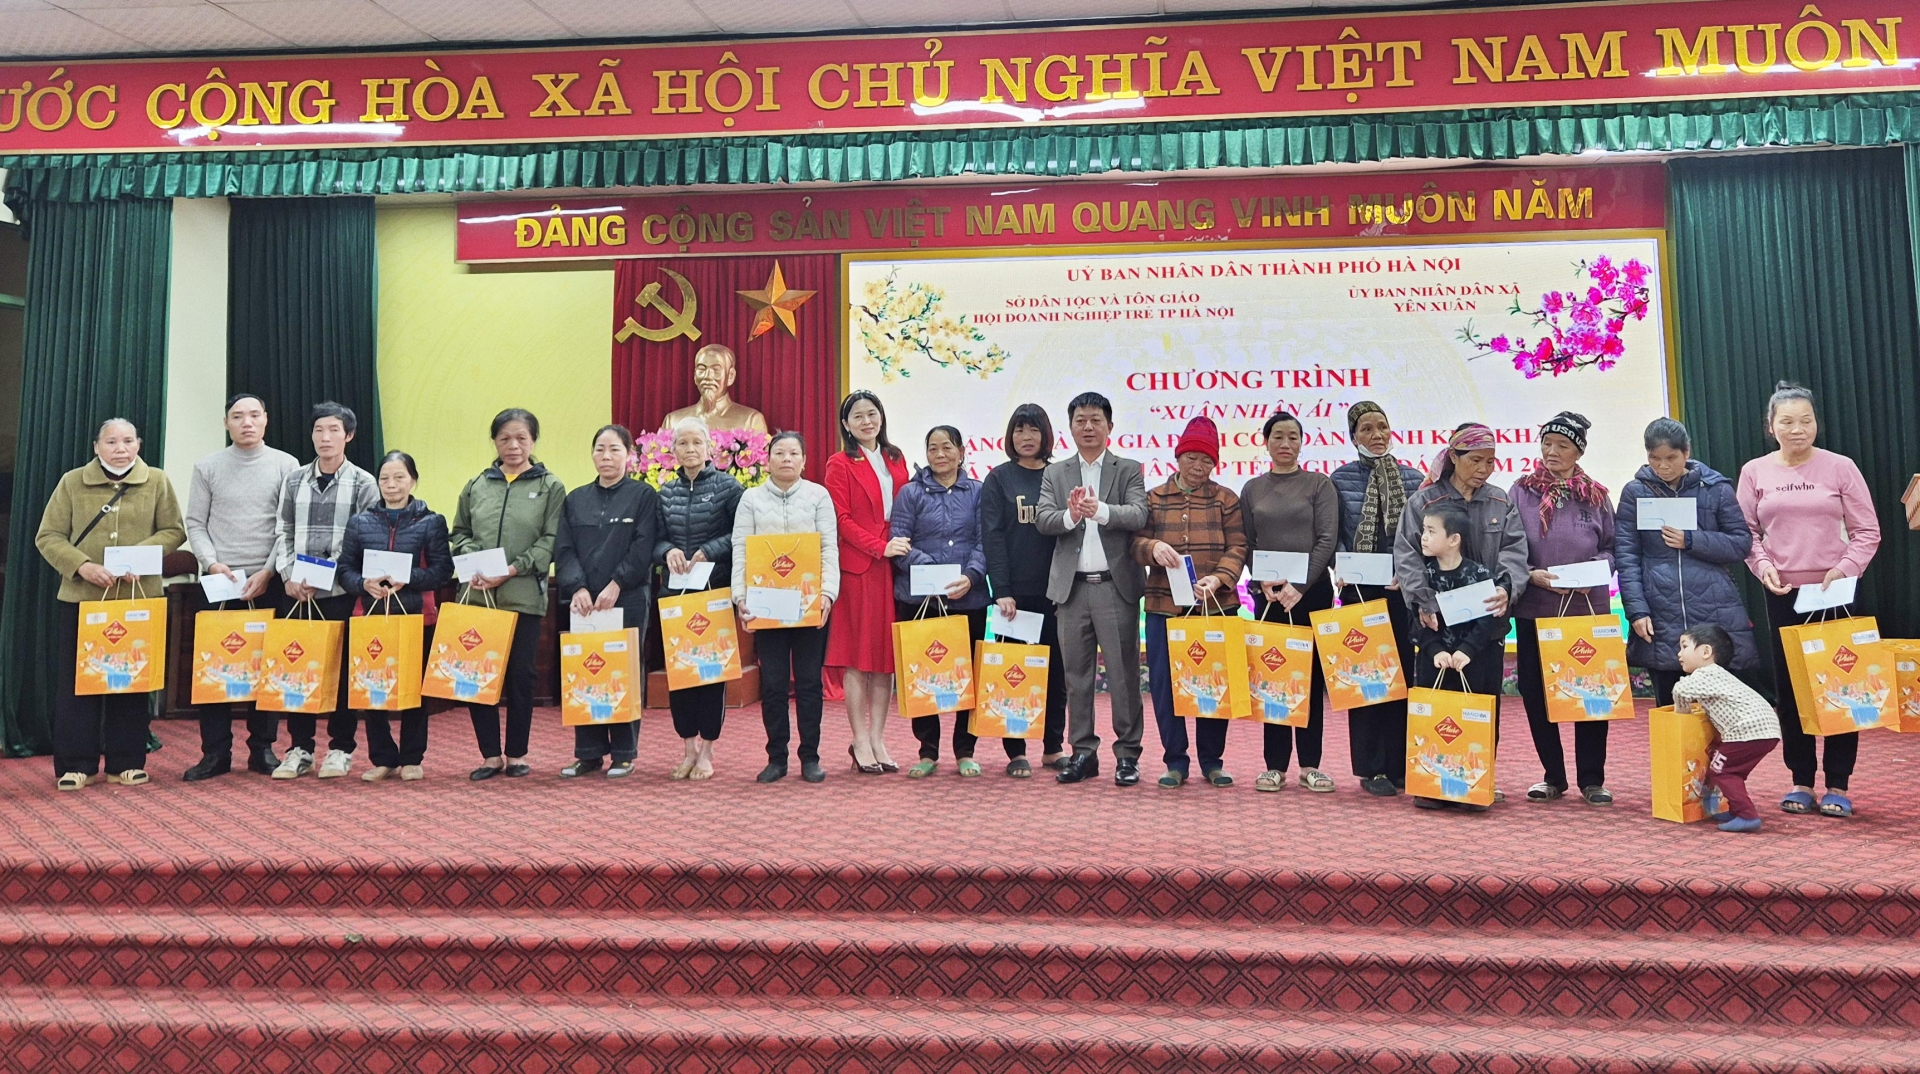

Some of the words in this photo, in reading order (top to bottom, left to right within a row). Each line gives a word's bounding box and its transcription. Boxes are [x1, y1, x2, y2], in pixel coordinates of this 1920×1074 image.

[146, 67, 336, 141] CỘNG
[359, 59, 504, 122] HÒA
[529, 59, 632, 118] XÃ
[652, 52, 780, 127] HỘI
[808, 38, 955, 108] CHỦ
[980, 36, 1221, 104] NGHĨA
[1242, 27, 1421, 103] VIỆT
[1452, 30, 1630, 84] NAM
[1655, 5, 1903, 77] MUÔN
[514, 204, 626, 248] ĐẢNG
[642, 205, 754, 252] CỘNG
[769, 196, 850, 240] SẢN
[864, 199, 950, 247] VIỆT
[966, 202, 1056, 236] NAM
[1072, 198, 1216, 232] QUANG
[1233, 194, 1330, 229] VINH
[1349, 181, 1477, 226] MUÔN
[1493, 178, 1595, 222] NĂM
[1067, 265, 1095, 282] UỶ
[1100, 266, 1141, 281] BAN
[1146, 262, 1204, 280] NHÂN
[1210, 262, 1253, 278] DÂN
[1258, 258, 1333, 277] THÀNH
[1338, 253, 1381, 275] PHỐ
[1387, 255, 1417, 274] HÀ
[1423, 254, 1461, 274] NỘI
[1006, 296, 1027, 309] SỞ
[1029, 294, 1062, 308] DÂN
[1066, 295, 1097, 309] TỘC
[1101, 293, 1121, 306] VÀ
[1125, 291, 1156, 305] TÔN
[1159, 291, 1201, 304] GIÁO
[1373, 287, 1406, 298] BAN
[1410, 283, 1456, 297] NHÂN
[1460, 282, 1494, 296] DÂN
[1498, 282, 1520, 295] XÃ
[1393, 299, 1427, 313] YÊN
[1430, 298, 1477, 312] XUÂN
[973, 312, 1001, 326] HỘI
[1005, 312, 1060, 323] DOANH
[1063, 309, 1122, 323] NGHIỆP
[1124, 306, 1154, 320] TRẺ
[1158, 309, 1177, 319] TP
[1180, 306, 1201, 319] HÀ
[1206, 307, 1235, 320] NỘI
[1126, 368, 1263, 392] CHƯƠNG
[1270, 363, 1371, 389] TRÌNH
[1232, 400, 1302, 419] NHÂN
[1117, 433, 1161, 449] GIA
[1551, 424, 1575, 440] USA
[1575, 436, 1586, 451] US
